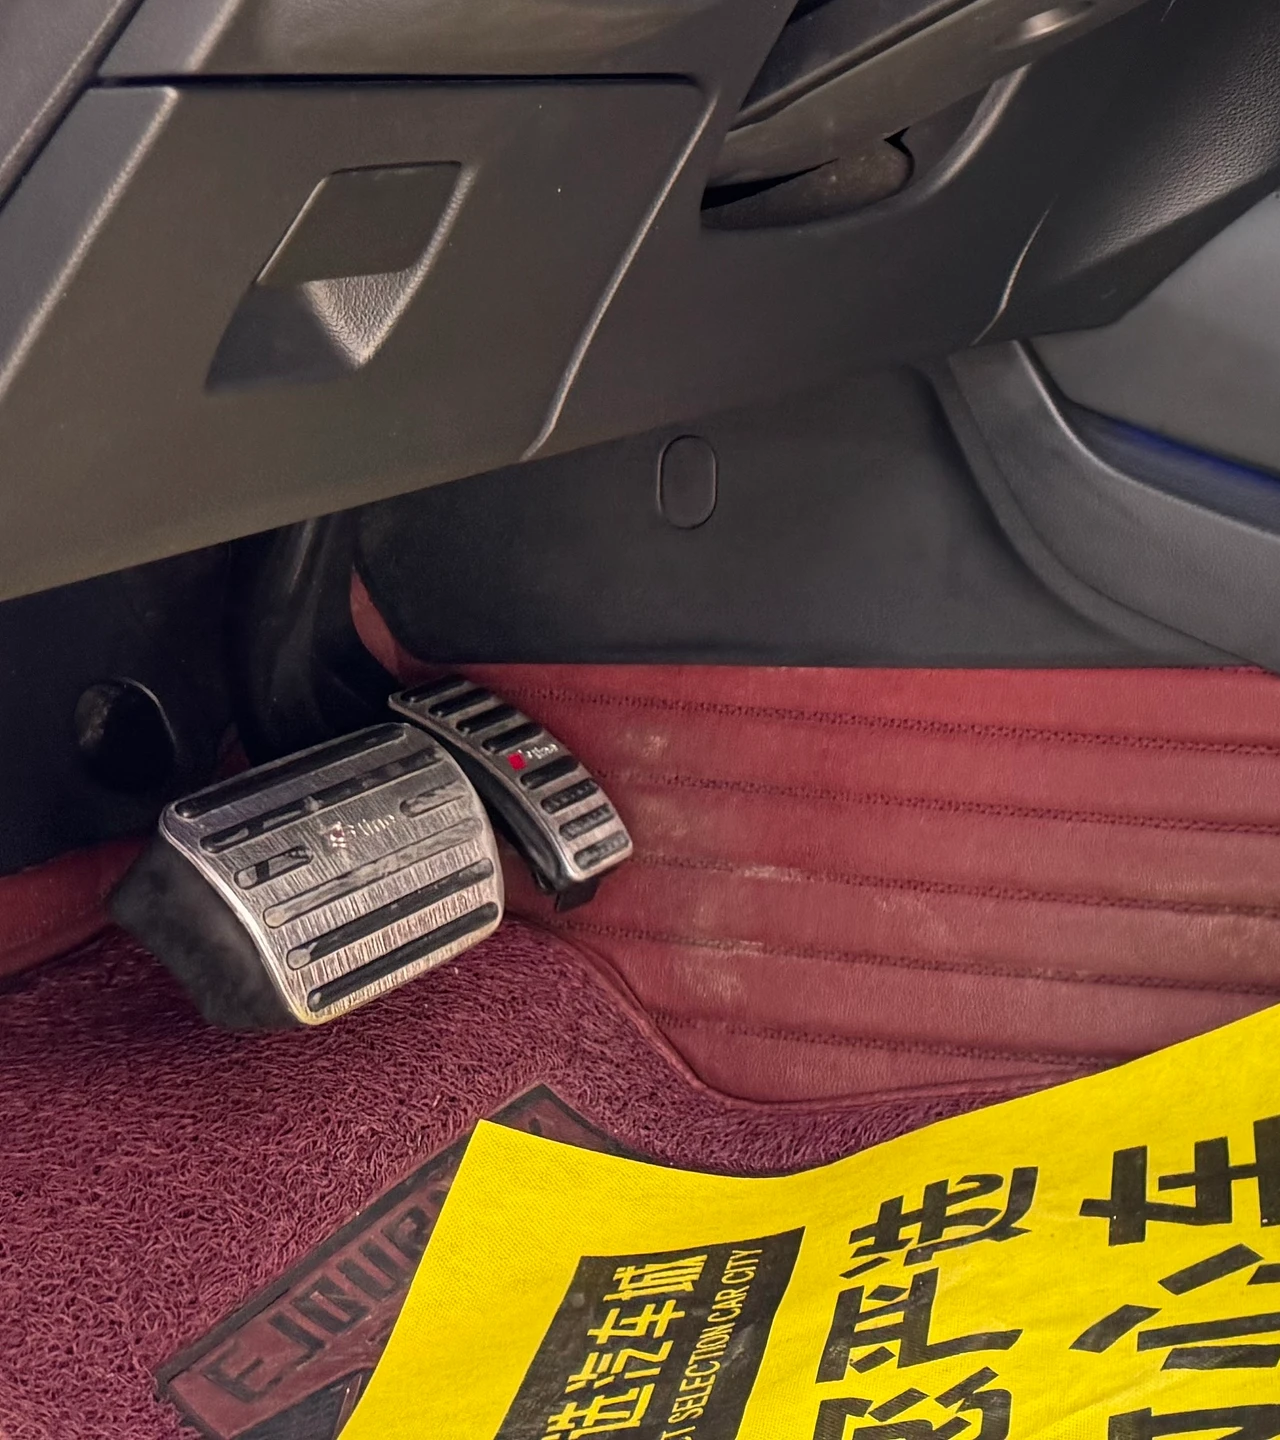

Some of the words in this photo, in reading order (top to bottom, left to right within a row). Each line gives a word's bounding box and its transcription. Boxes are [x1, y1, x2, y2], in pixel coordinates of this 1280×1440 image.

[721, 1248, 763, 1284] CITY
[707, 1284, 750, 1323] CAR
[667, 1319, 735, 1425] SELECTION
